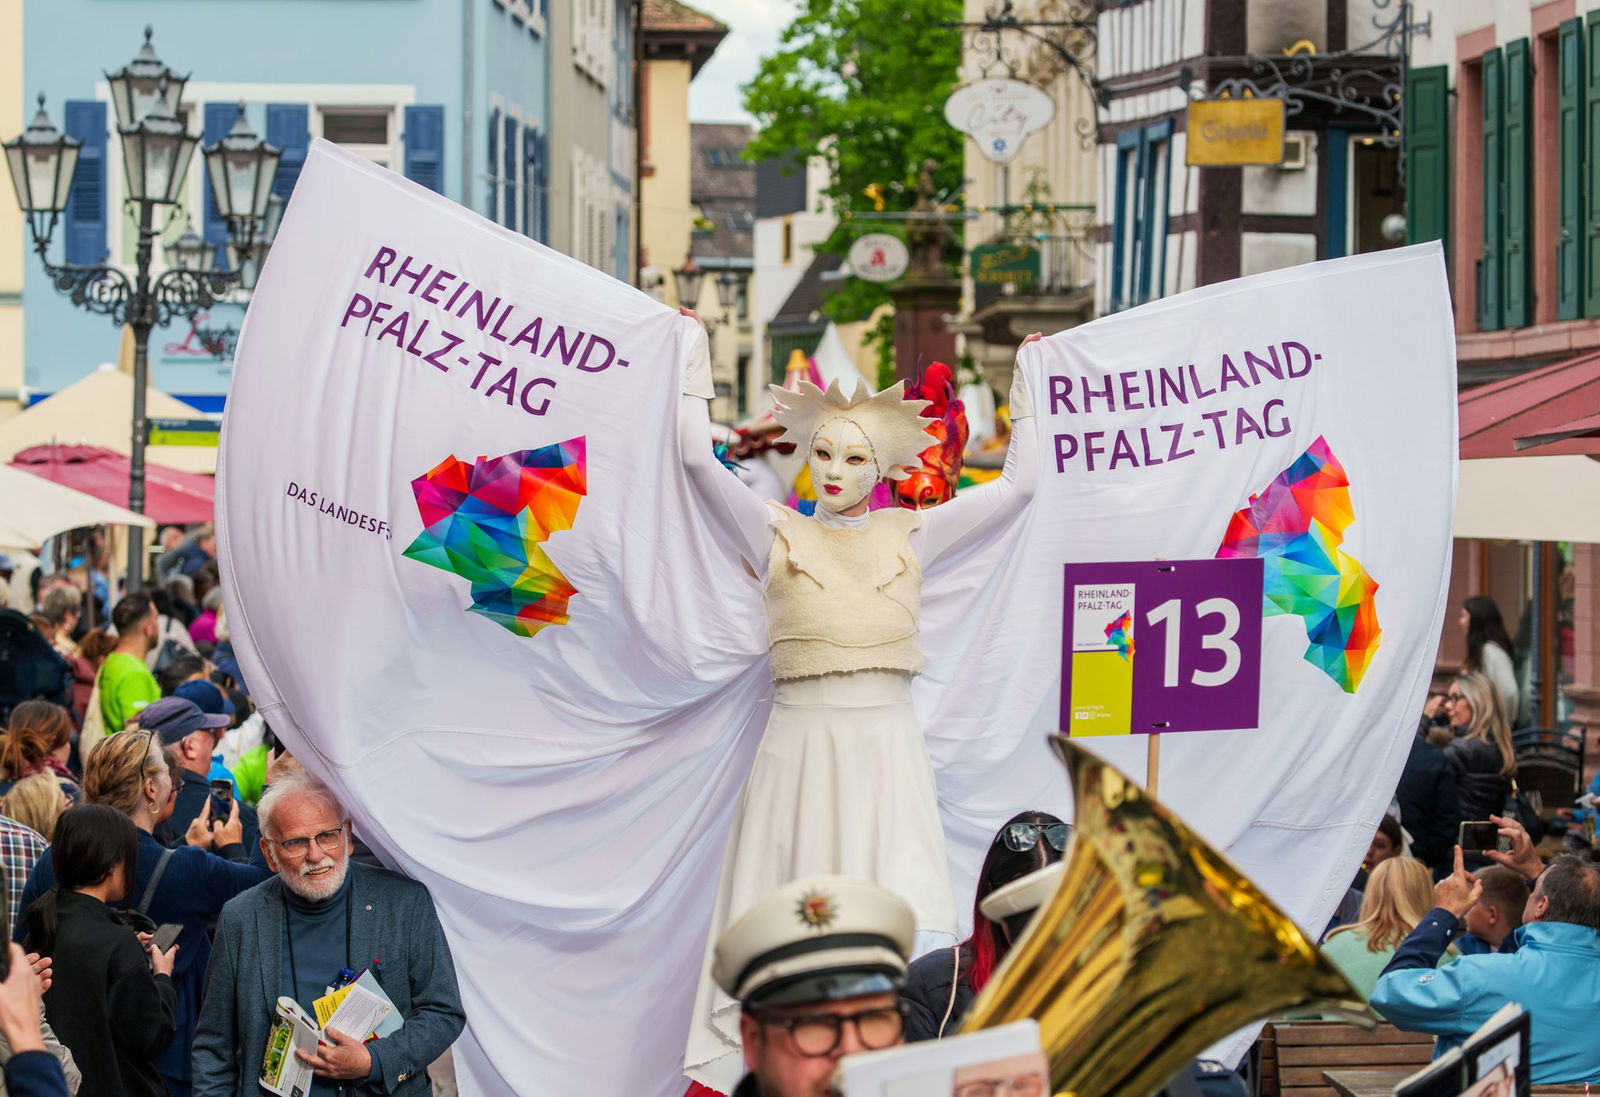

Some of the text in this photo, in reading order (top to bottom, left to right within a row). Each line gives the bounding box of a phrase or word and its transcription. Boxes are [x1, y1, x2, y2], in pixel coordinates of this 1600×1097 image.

[364, 246, 630, 373] RHEINLAND-
[341, 293, 557, 416] PFALZ-TAG
[1049, 341, 1322, 415] RHEINLAND-
[1054, 399, 1291, 473] PFALZ-TAG
[287, 482, 318, 507] DAS
[1078, 589, 1132, 599] RHEINLAND-
[1078, 601, 1123, 610] PFALZ-TAG
[1146, 597, 1242, 688] 13
